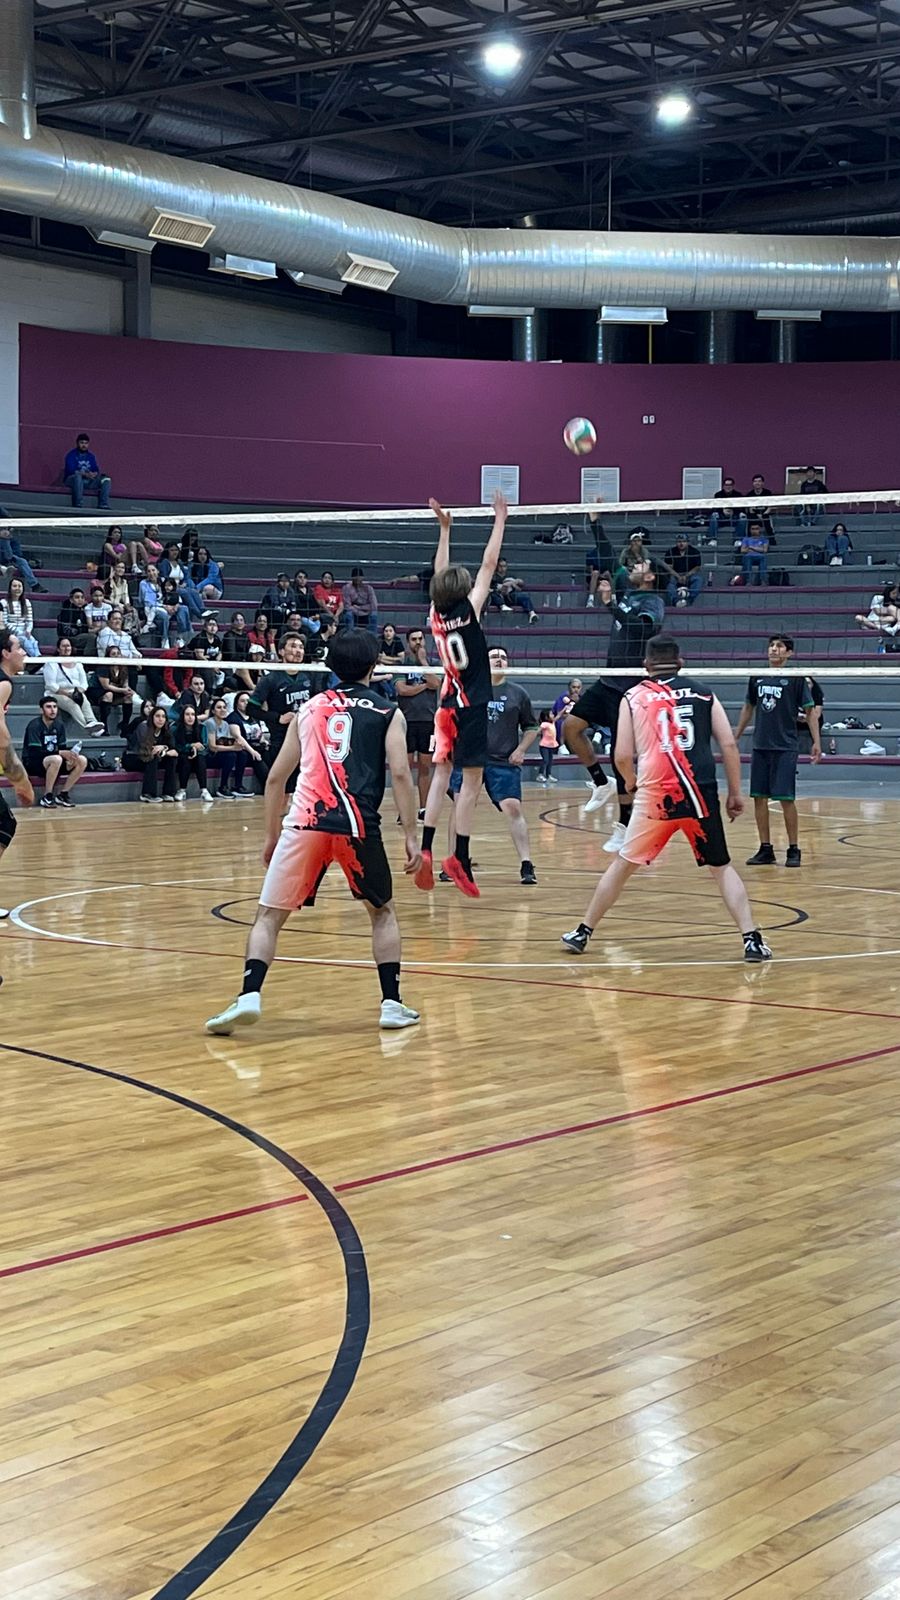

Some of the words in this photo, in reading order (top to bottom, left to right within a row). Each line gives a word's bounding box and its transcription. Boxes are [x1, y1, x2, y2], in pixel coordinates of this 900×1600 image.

[646, 688, 698, 702] PAUL
[325, 711, 353, 763] 9
[657, 704, 695, 753] 15
